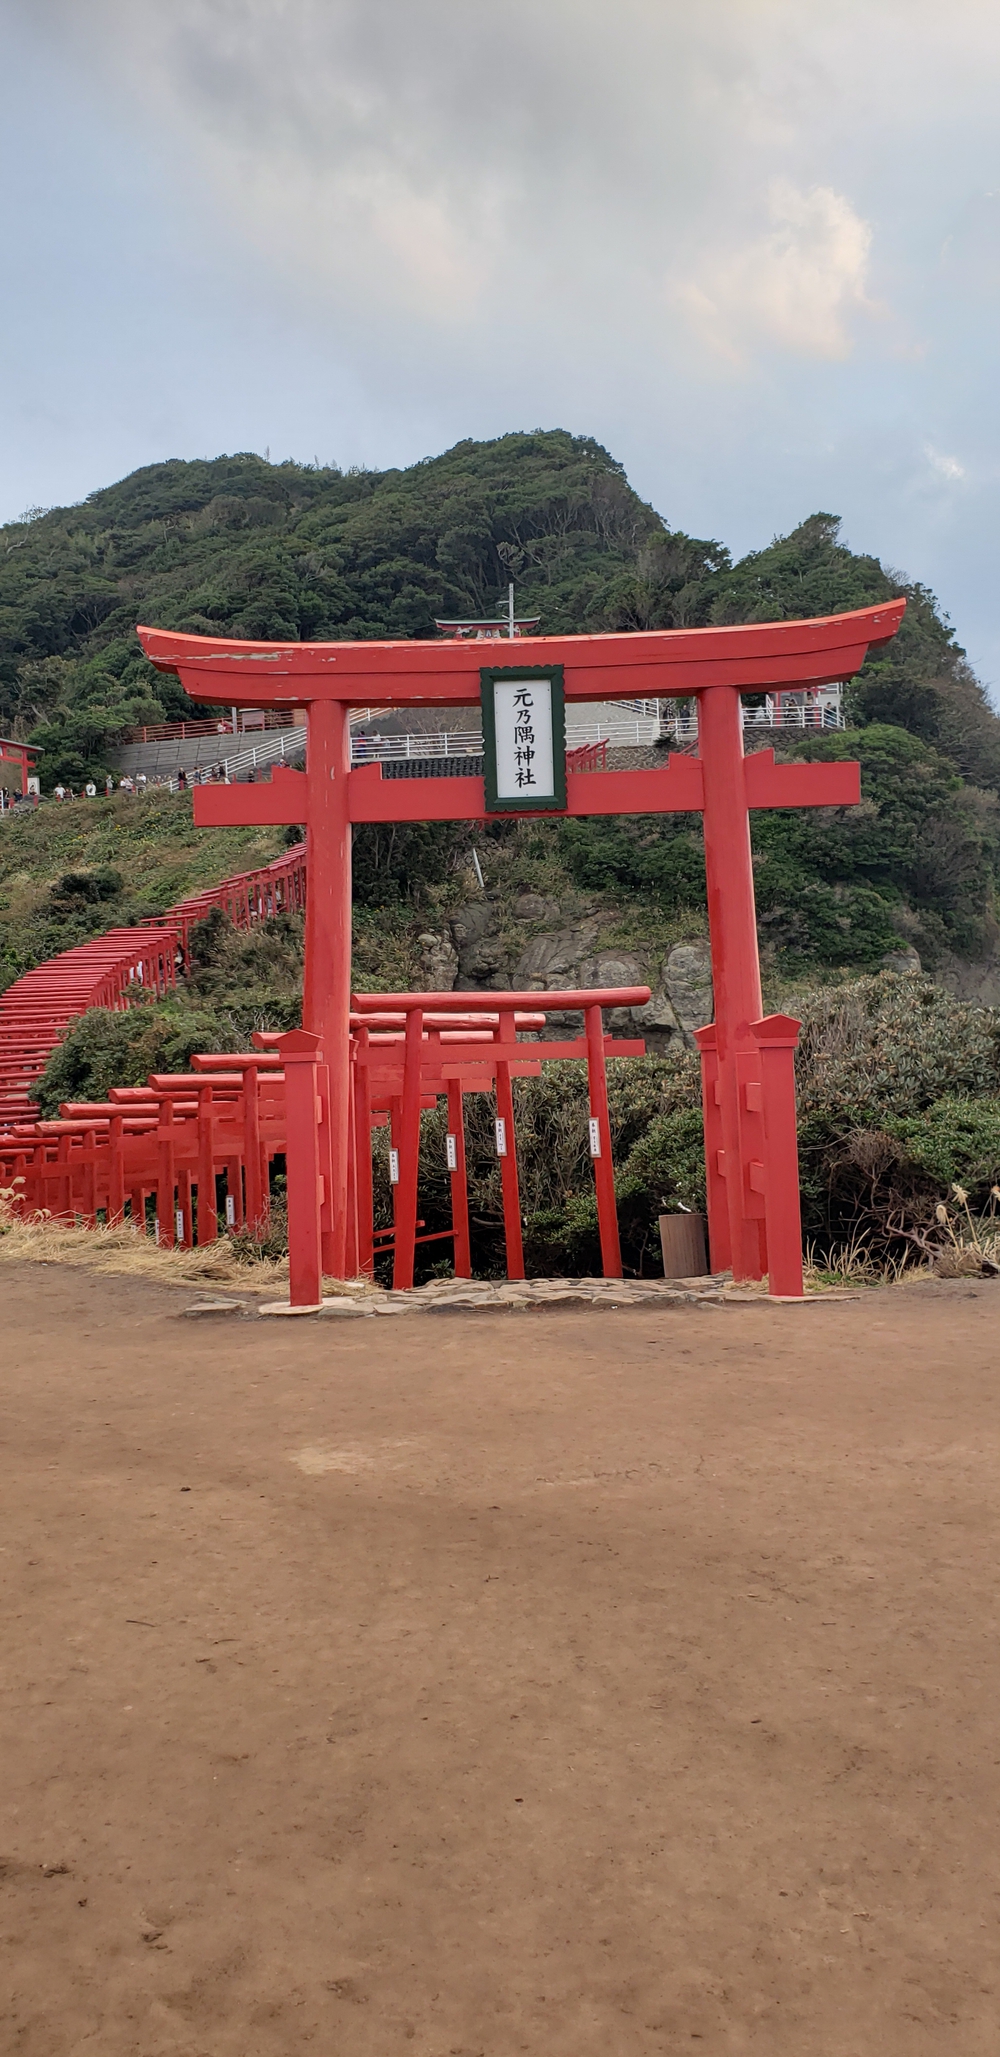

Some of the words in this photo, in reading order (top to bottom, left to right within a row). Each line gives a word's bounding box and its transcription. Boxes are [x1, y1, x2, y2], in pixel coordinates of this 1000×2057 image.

[512, 688, 536, 788] 元乃隅神社
